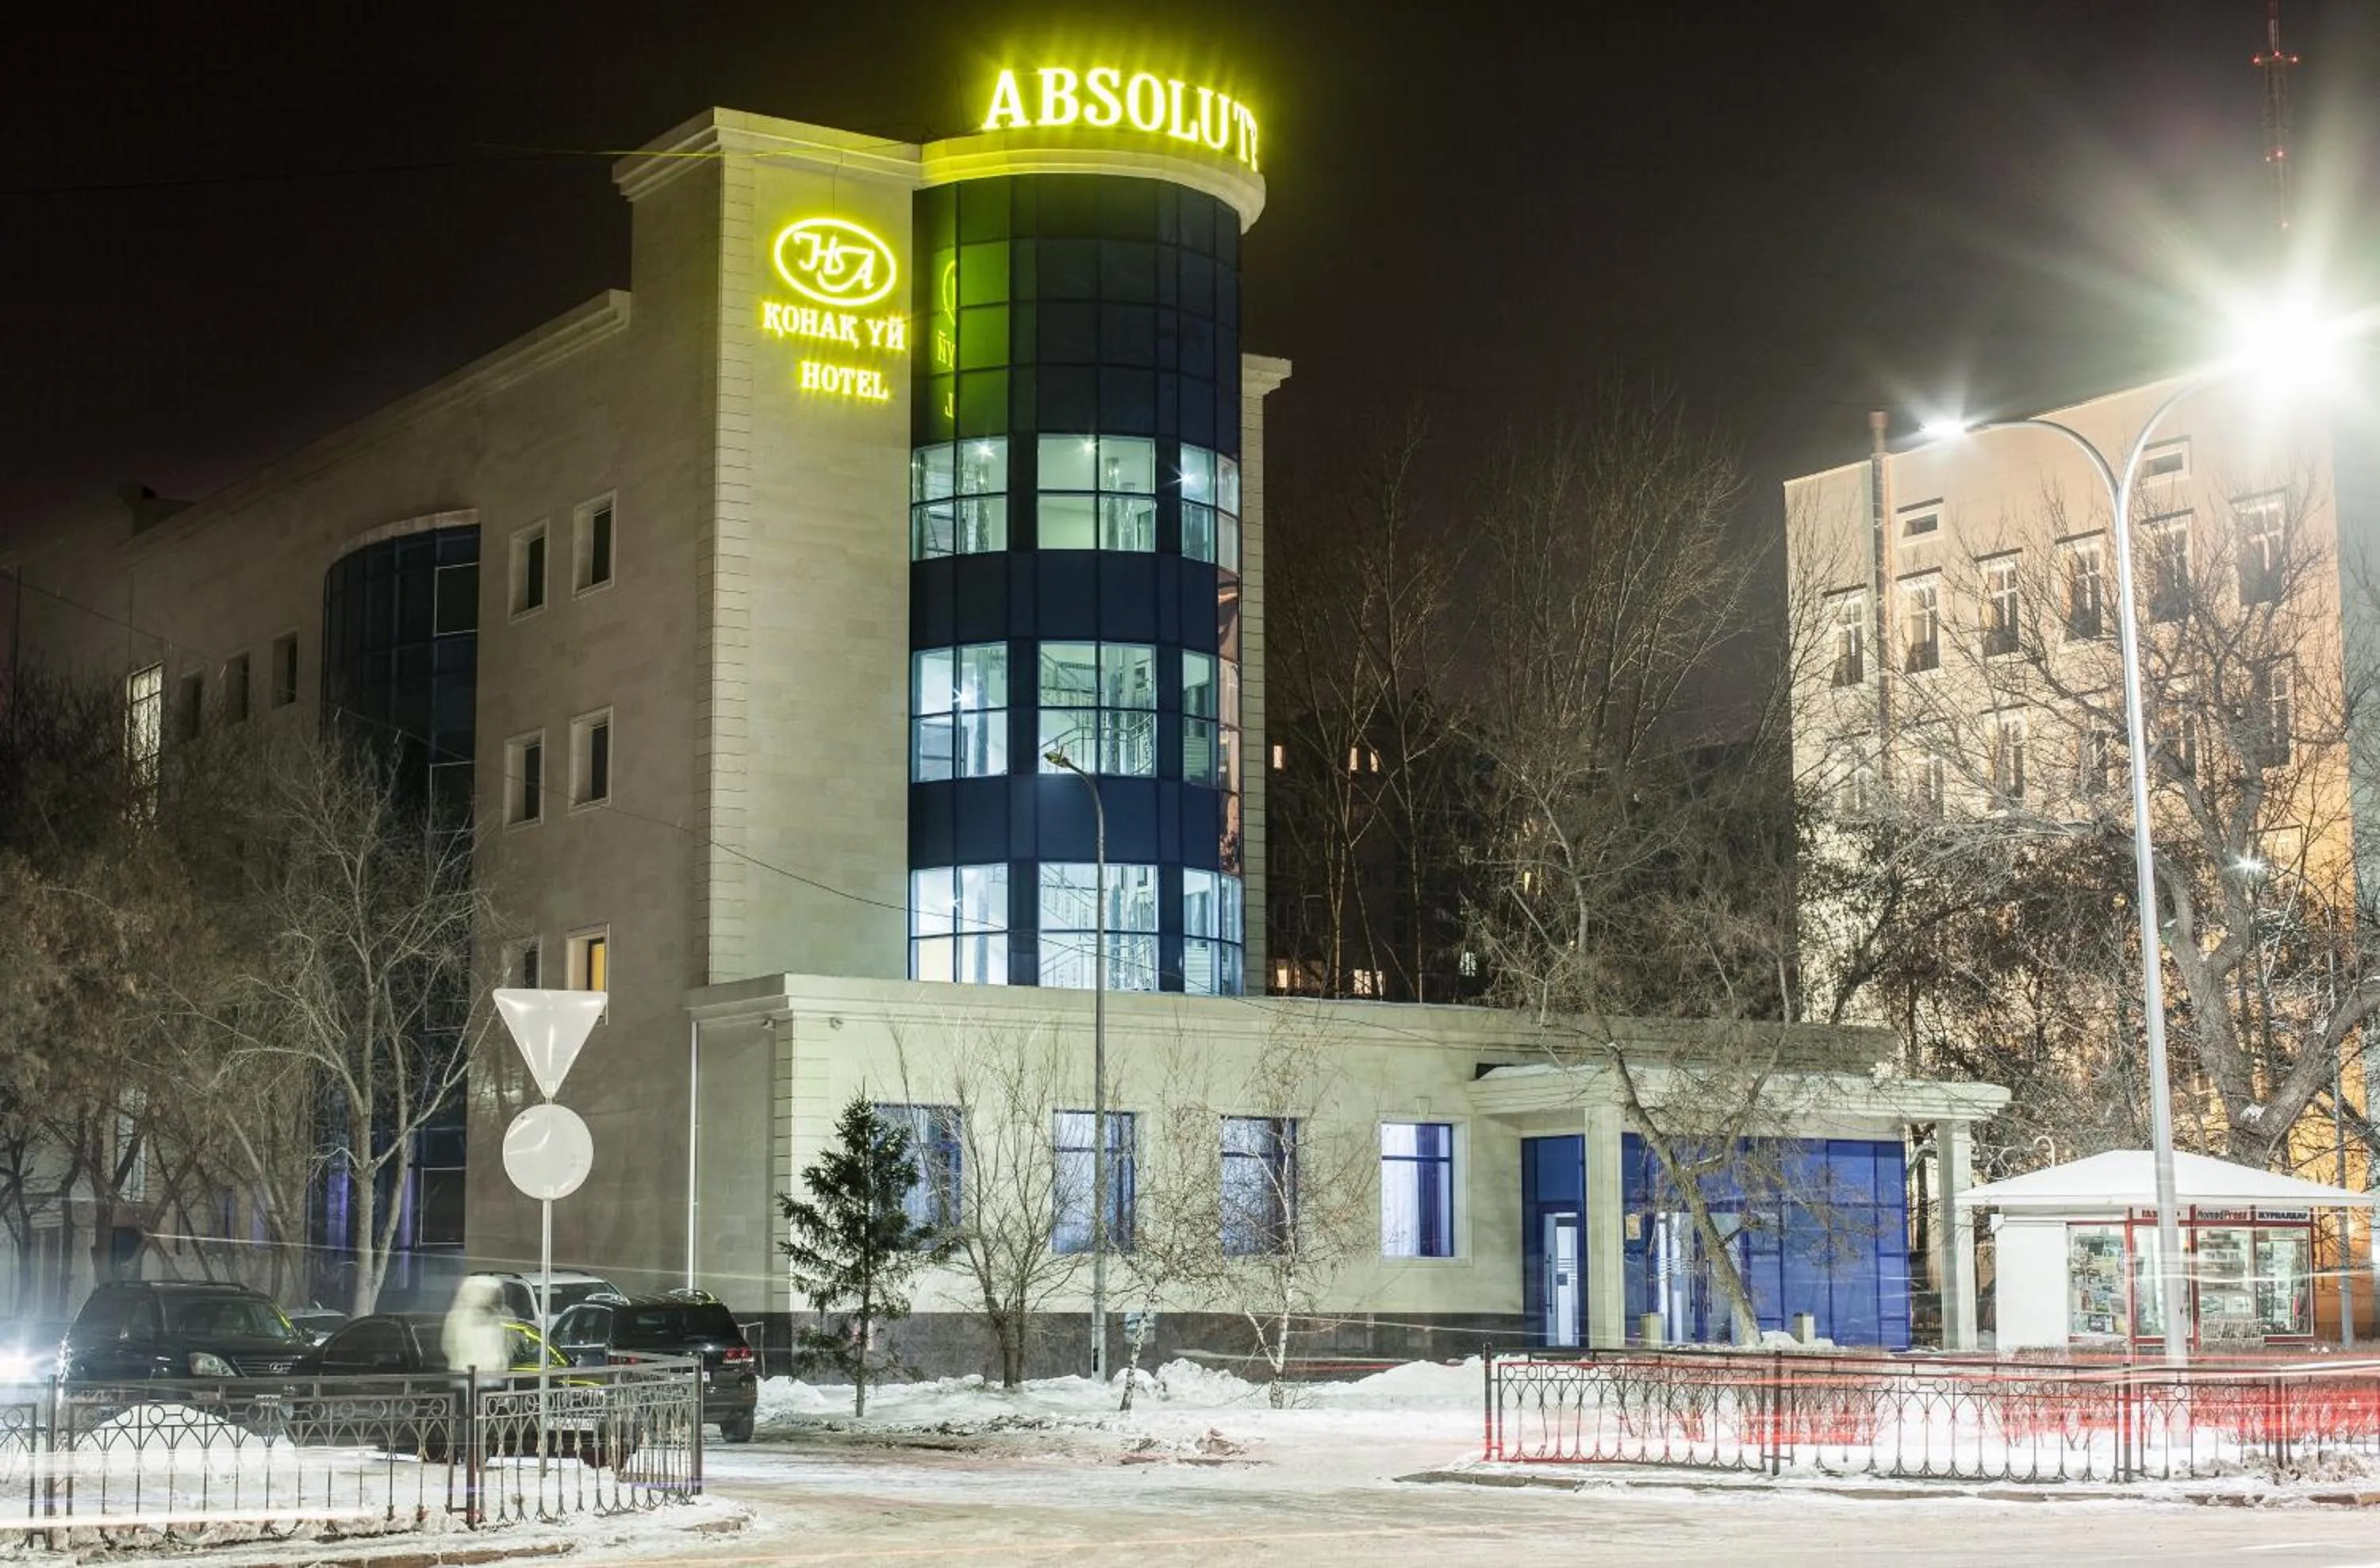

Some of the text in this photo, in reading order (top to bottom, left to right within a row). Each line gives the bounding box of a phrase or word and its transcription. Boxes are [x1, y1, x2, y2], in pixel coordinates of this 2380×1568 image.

[981, 66, 1258, 172] ABSOLUT
[762, 301, 859, 349] ҚОНАҚ
[800, 360, 889, 400] HOTEL
